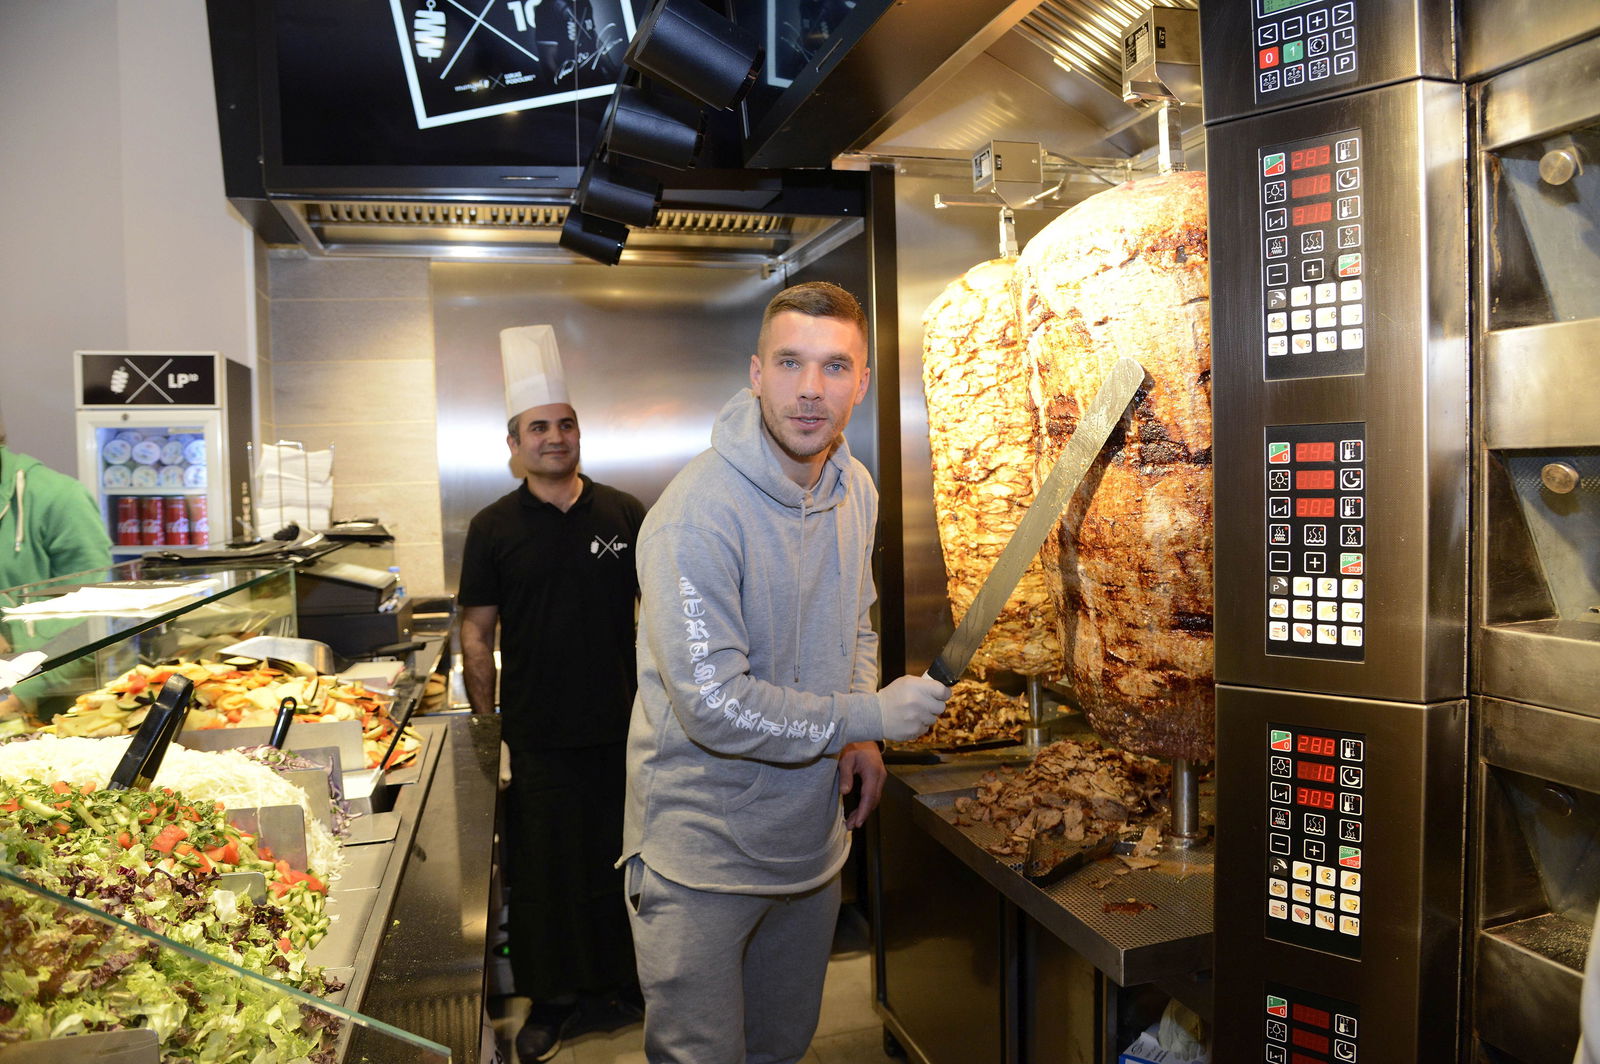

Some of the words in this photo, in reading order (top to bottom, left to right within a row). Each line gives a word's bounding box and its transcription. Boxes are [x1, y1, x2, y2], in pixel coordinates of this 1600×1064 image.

[1265, 53, 1274, 64] 0
[1290, 49, 1296, 57] 1
[1340, 57, 1350, 70] P
[1271, 299, 1278, 308] P
[1273, 584, 1279, 592] P
[1327, 583, 1332, 591] 2
[1354, 584, 1359, 592] 3
[1306, 629, 1311, 637] 9
[1326, 629, 1335, 637] 10
[1353, 629, 1361, 637] 11
[1298, 735, 1335, 756] 288
[1317, 764, 1335, 783] 10
[1297, 788, 1335, 809] 309
[1305, 869, 1309, 877] 1
[1326, 872, 1331, 880] 2
[1305, 889, 1310, 897] 5
[1352, 903, 1358, 911] 7
[1324, 915, 1334, 924] 10
[1350, 920, 1358, 928] 11
